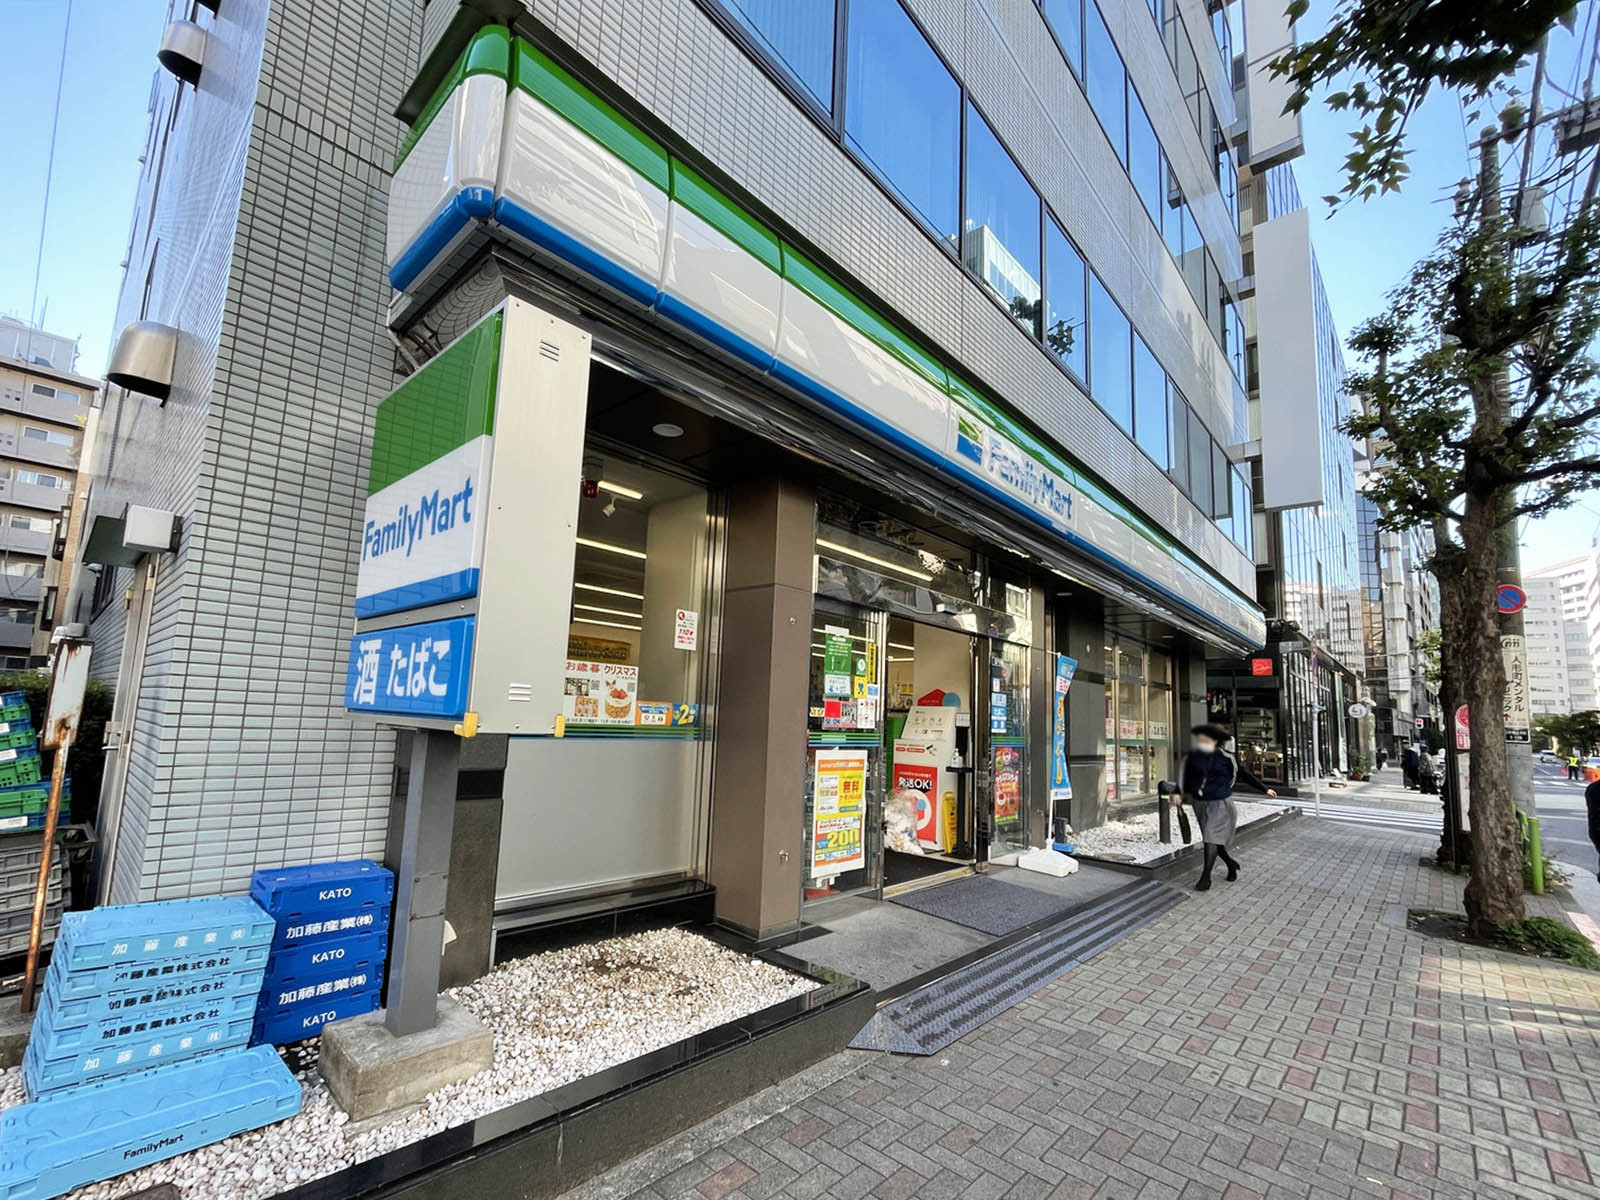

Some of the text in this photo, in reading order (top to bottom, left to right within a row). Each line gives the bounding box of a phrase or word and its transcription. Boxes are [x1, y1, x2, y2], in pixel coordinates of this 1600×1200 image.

[988, 437, 1072, 519] FamilyMart
[362, 476, 473, 561] FamilyMart
[353, 637, 451, 705] 酒 たばこ
[603, 665, 637, 677] クリスマス
[1512, 655, 1524, 712] 人形町メンタル
[319, 887, 351, 900] KATO
[312, 948, 345, 964] KATO
[102, 1009, 220, 1039] 加藤産業株式会社
[303, 1010, 336, 1028] KATO
[123, 1133, 184, 1160] FamilyMart
